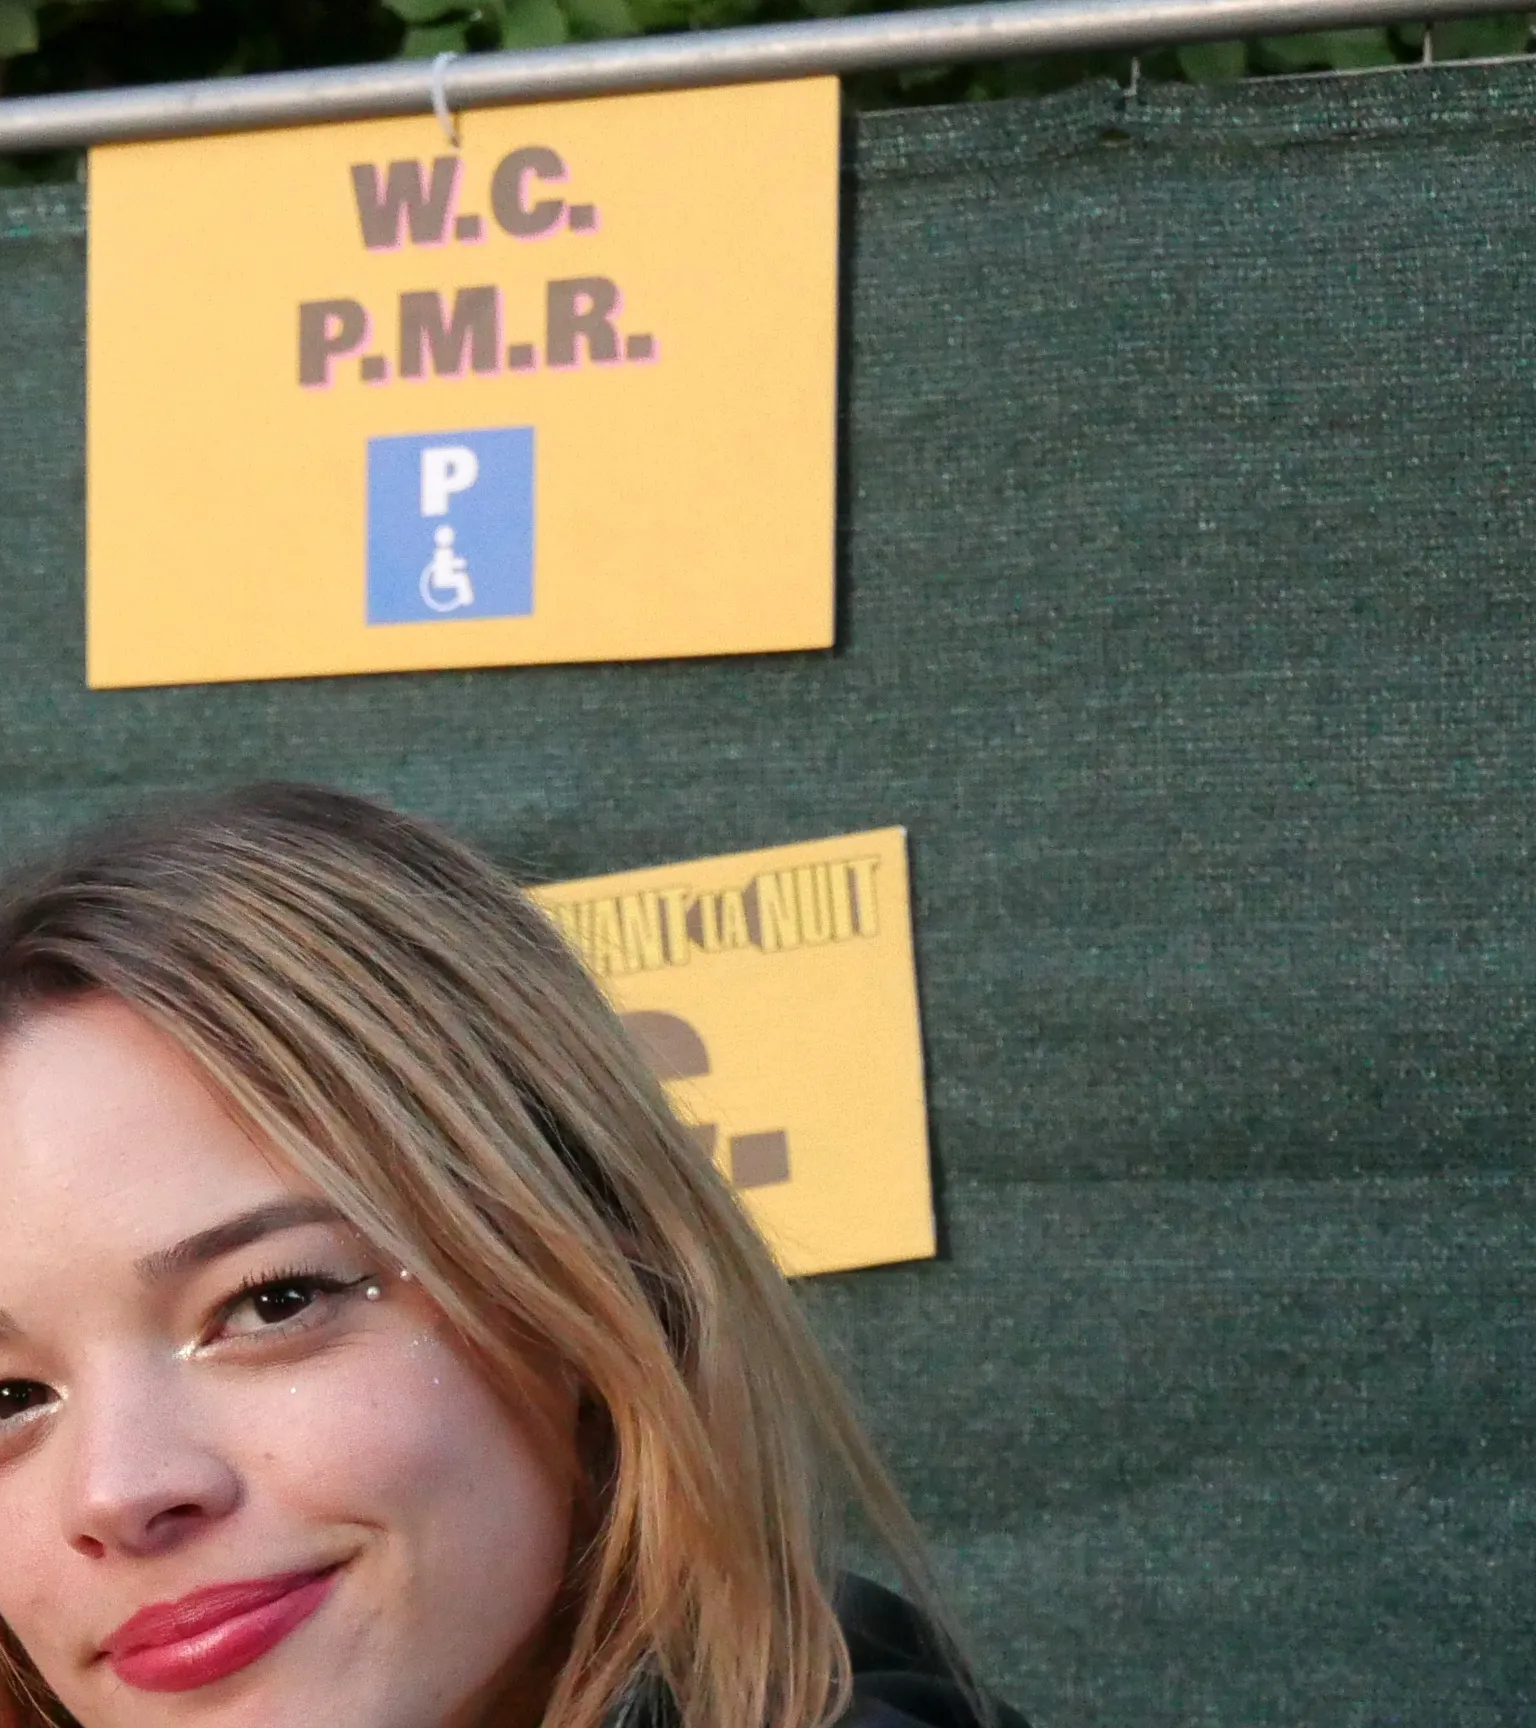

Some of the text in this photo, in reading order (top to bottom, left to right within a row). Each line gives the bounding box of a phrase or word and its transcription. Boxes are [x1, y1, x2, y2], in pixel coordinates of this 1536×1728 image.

[350, 145, 600, 252] W.C.
[297, 275, 660, 389] P.M.R.
[418, 446, 479, 518] P
[757, 857, 881, 953] NUIT
